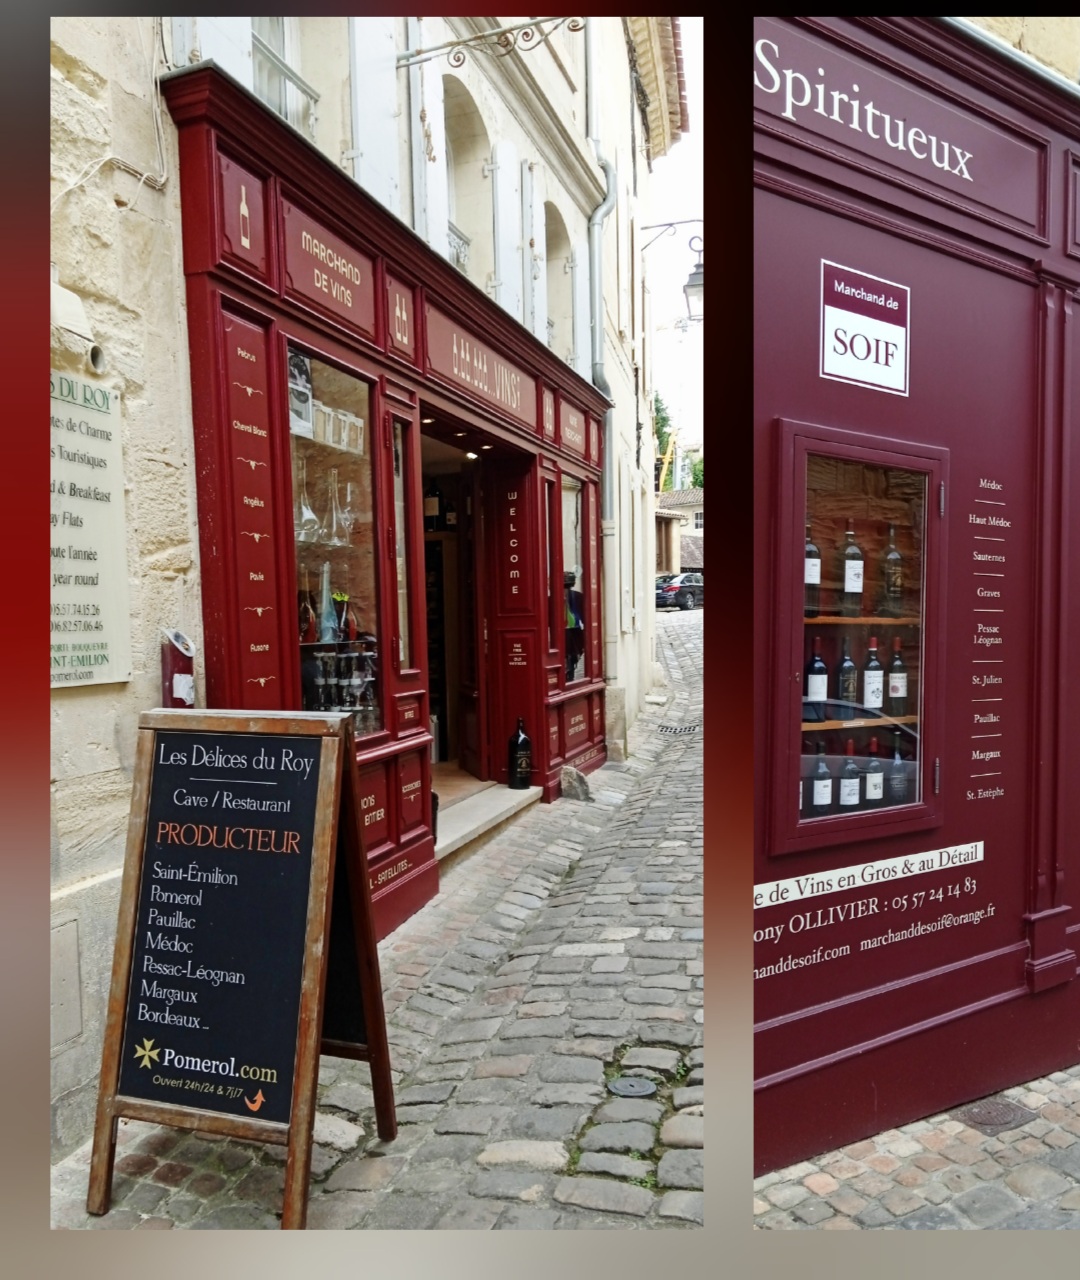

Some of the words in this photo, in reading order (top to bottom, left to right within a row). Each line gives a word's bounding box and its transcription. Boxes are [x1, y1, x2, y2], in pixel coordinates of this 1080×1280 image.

[753, 38, 975, 182] Spiritueux
[301, 230, 361, 286] MARCHAND
[313, 267, 329, 293] DE
[330, 277, 353, 308] VINS
[833, 280, 885, 305] Marchand
[885, 294, 899, 311] de
[237, 347, 257, 362] Petrus
[832, 325, 899, 368] SOIF
[59, 376, 78, 401] DU
[83, 384, 111, 410] ROY
[66, 418, 77, 433] de
[79, 420, 112, 442] Charme
[57, 444, 108, 469] Touristiques
[57, 480, 66, 495] &
[69, 482, 111, 503] Breakfeast
[979, 478, 1003, 490] Médoc
[62, 511, 84, 528] Flats
[968, 513, 987, 526] Haut
[988, 515, 1011, 528] Médoc
[507, 491, 520, 594] WELCOME
[973, 551, 1006, 563] Sauternes
[53, 573, 73, 587] year
[74, 572, 99, 587] round
[977, 587, 1001, 598] Graves
[973, 634, 1003, 647] Léognan
[977, 624, 1000, 635] Pessac
[971, 675, 982, 685] St.
[982, 675, 1003, 687] Julien
[974, 713, 1000, 724] Pauillac
[158, 743, 187, 766] Les
[191, 743, 248, 770] Délices
[252, 748, 275, 771] du
[280, 748, 315, 781] Roy
[971, 750, 1001, 762] Margaux
[173, 788, 208, 808] Cave
[211, 790, 220, 808] /
[222, 791, 292, 813] Restaurant
[966, 790, 977, 801] St.
[977, 786, 1005, 800] Estèphe
[156, 822, 301, 854] PRODUCTEUR
[152, 860, 239, 887] Saint-Émilion
[769, 885, 790, 903] de
[795, 877, 833, 897] Vins
[837, 874, 857, 888] en
[861, 864, 898, 885] Gros
[901, 859, 915, 875] &
[918, 857, 935, 872] au
[938, 843, 979, 867] Détail
[149, 885, 203, 907] Pomerol
[147, 907, 197, 930] Pauillac
[754, 923, 785, 944] ony
[788, 897, 880, 934] OLLIVIER
[892, 895, 908, 913] 05
[911, 891, 926, 909] 57
[929, 886, 944, 902] 24
[947, 883, 961, 900] 14
[963, 876, 977, 895] 83
[859, 902, 996, 952] marchanddesoif@orange.fr
[144, 931, 194, 954] Médoc
[142, 955, 246, 987] Pessac-Léognan
[140, 979, 198, 1006] Margaux
[161, 1048, 278, 1084] Pomerol.com
[152, 1074, 183, 1090] Ouvert
[184, 1078, 215, 1094] 24h/24
[217, 1084, 224, 1095] &
[226, 1086, 244, 1099] 7j/7
